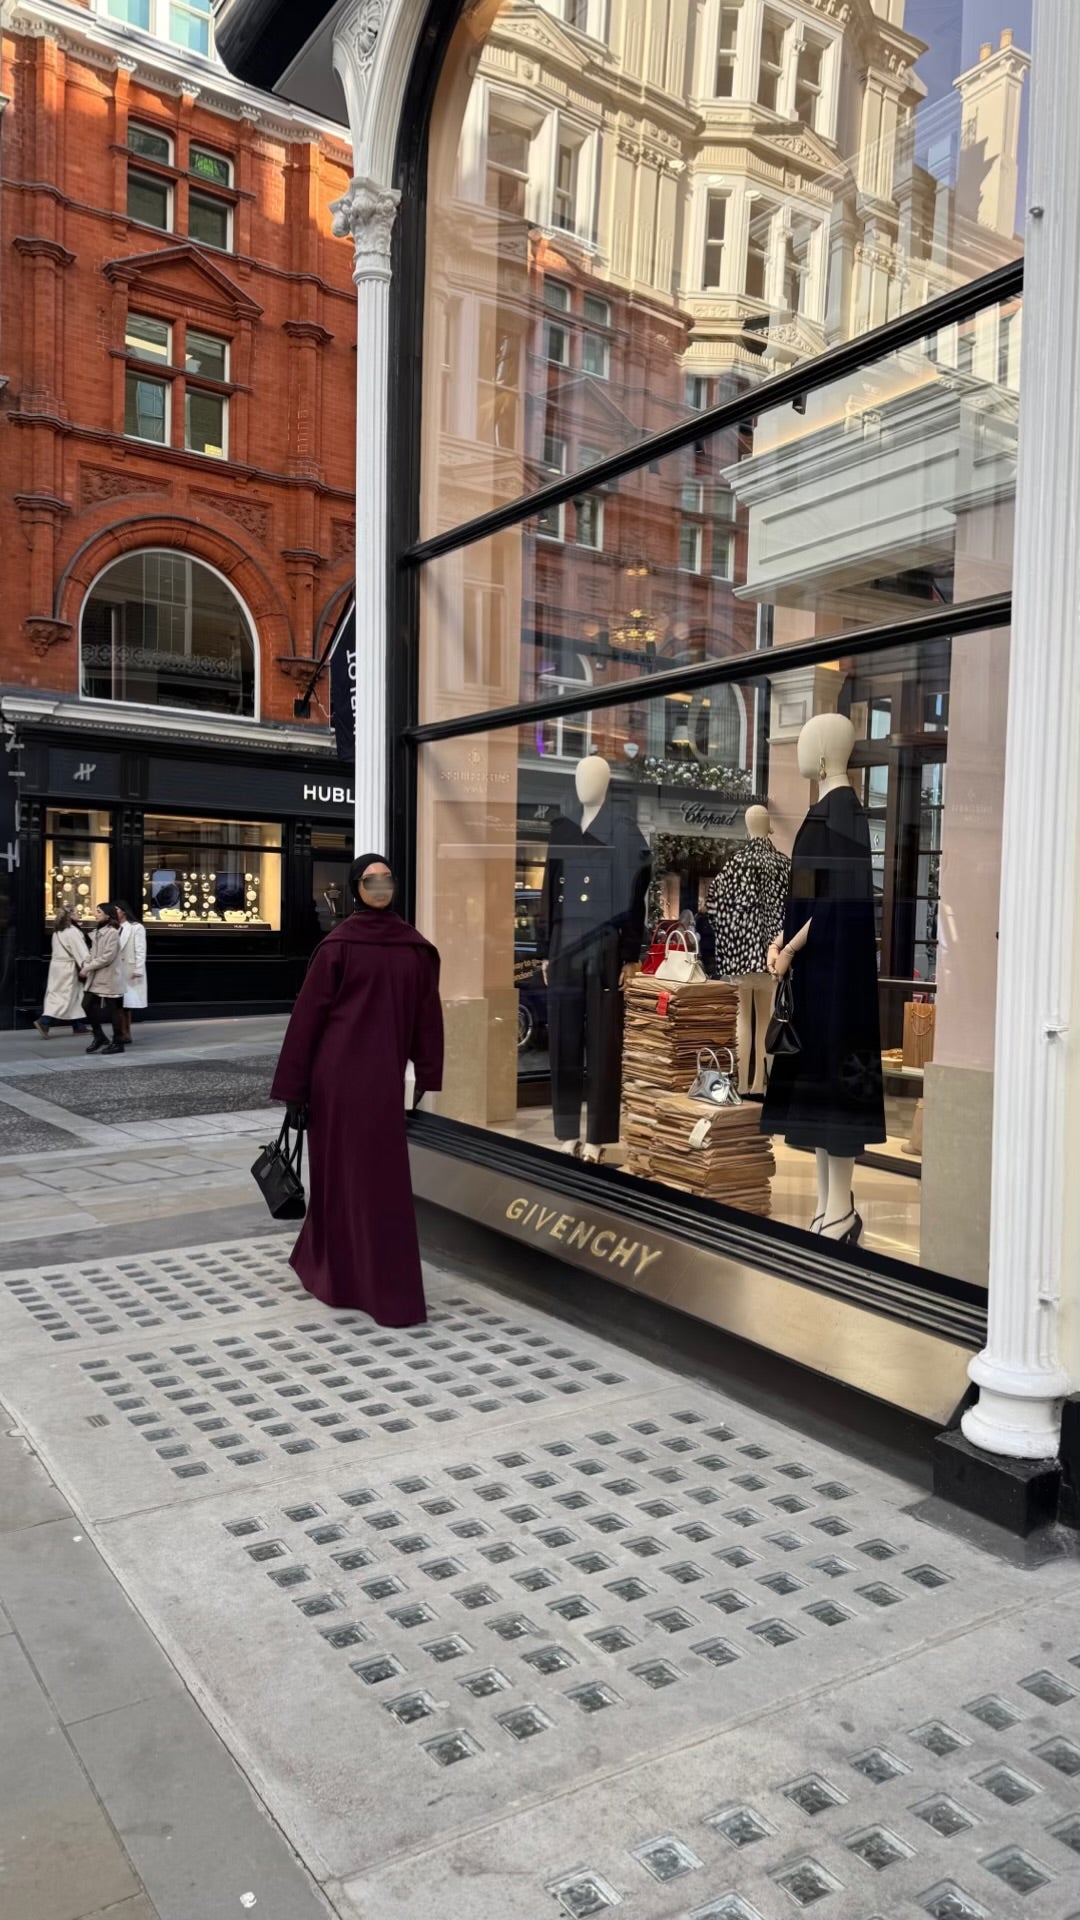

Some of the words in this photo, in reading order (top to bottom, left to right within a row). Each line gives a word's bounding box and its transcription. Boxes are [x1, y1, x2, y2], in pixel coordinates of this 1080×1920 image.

[303, 784, 356, 803] HUBL
[681, 801, 739, 830] Chopard
[505, 1198, 663, 1276] GIVENCHY
